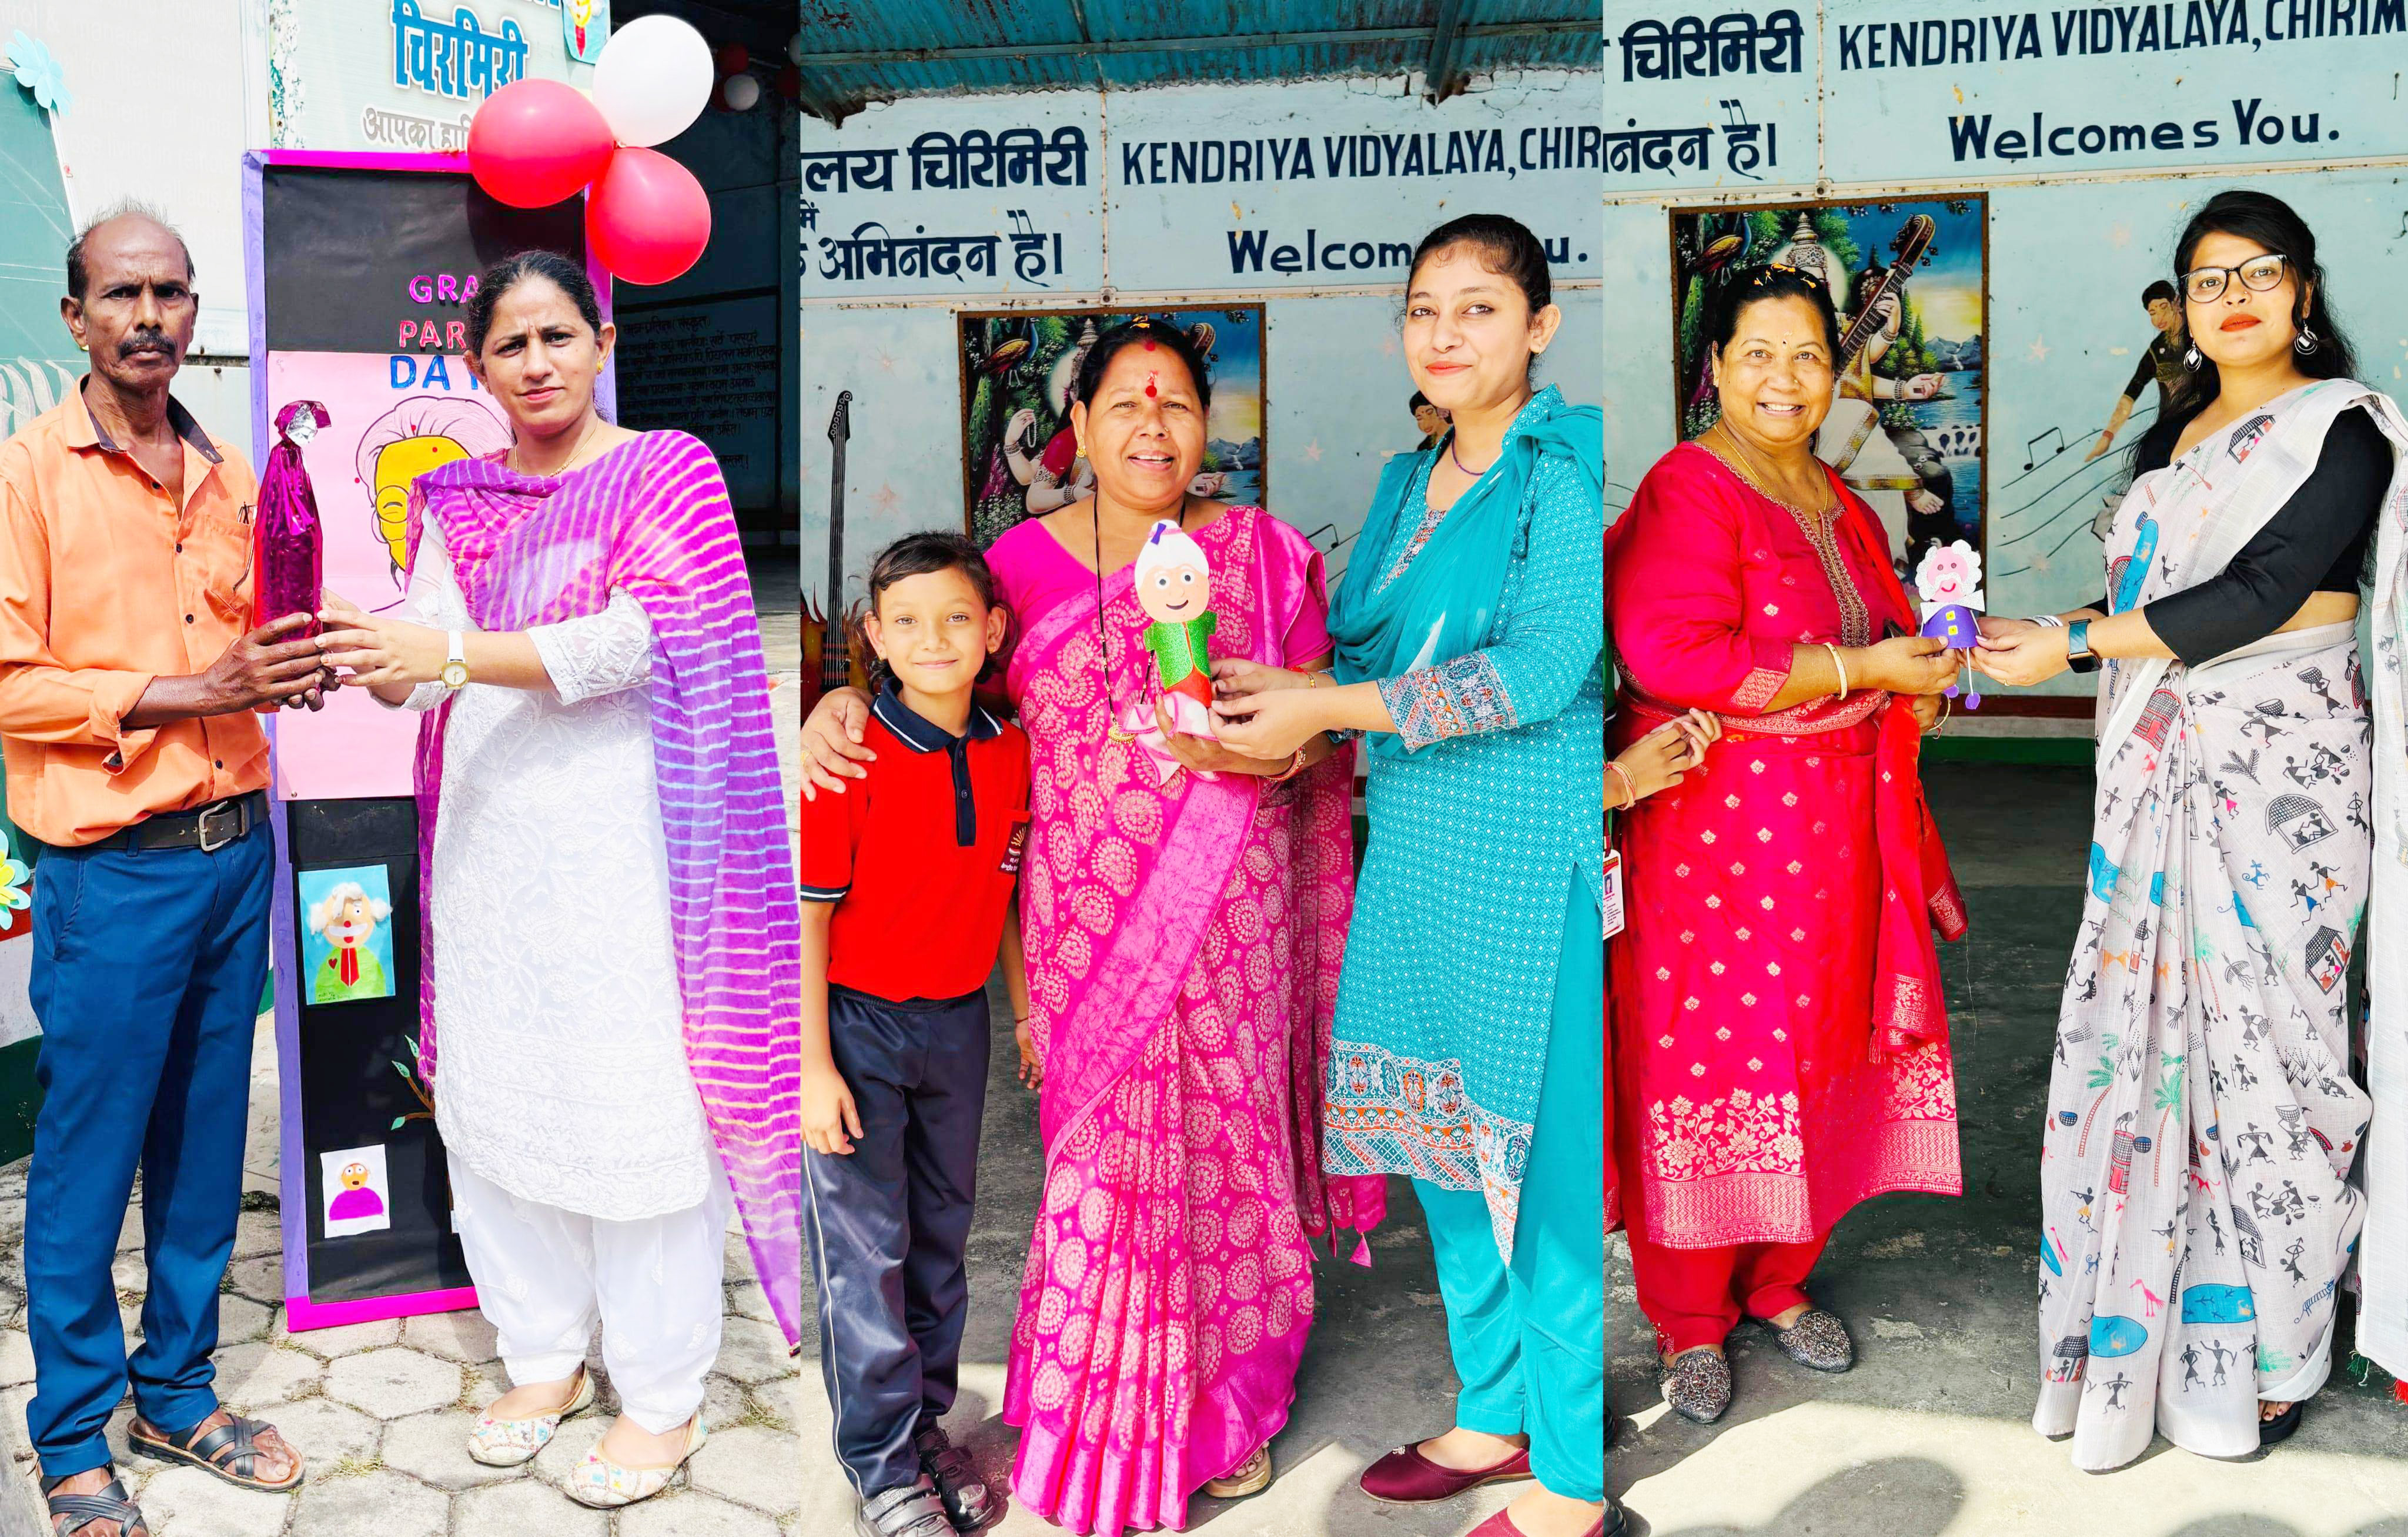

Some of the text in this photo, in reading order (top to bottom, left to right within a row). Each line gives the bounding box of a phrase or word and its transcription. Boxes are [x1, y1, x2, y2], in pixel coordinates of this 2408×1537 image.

[1618, 9, 1804, 82] चिरिमिरी
[1839, 13, 2042, 71] KENDRIYA
[363, 107, 434, 149] आपका
[1603, 118, 1714, 177] नंदन
[1948, 98, 2339, 162] Welcomes You.
[907, 126, 1089, 190] चिरिमिरी
[1122, 137, 1315, 186] KENDRIYA
[1227, 229, 1412, 274] Welcom
[409, 274, 480, 305] GRA
